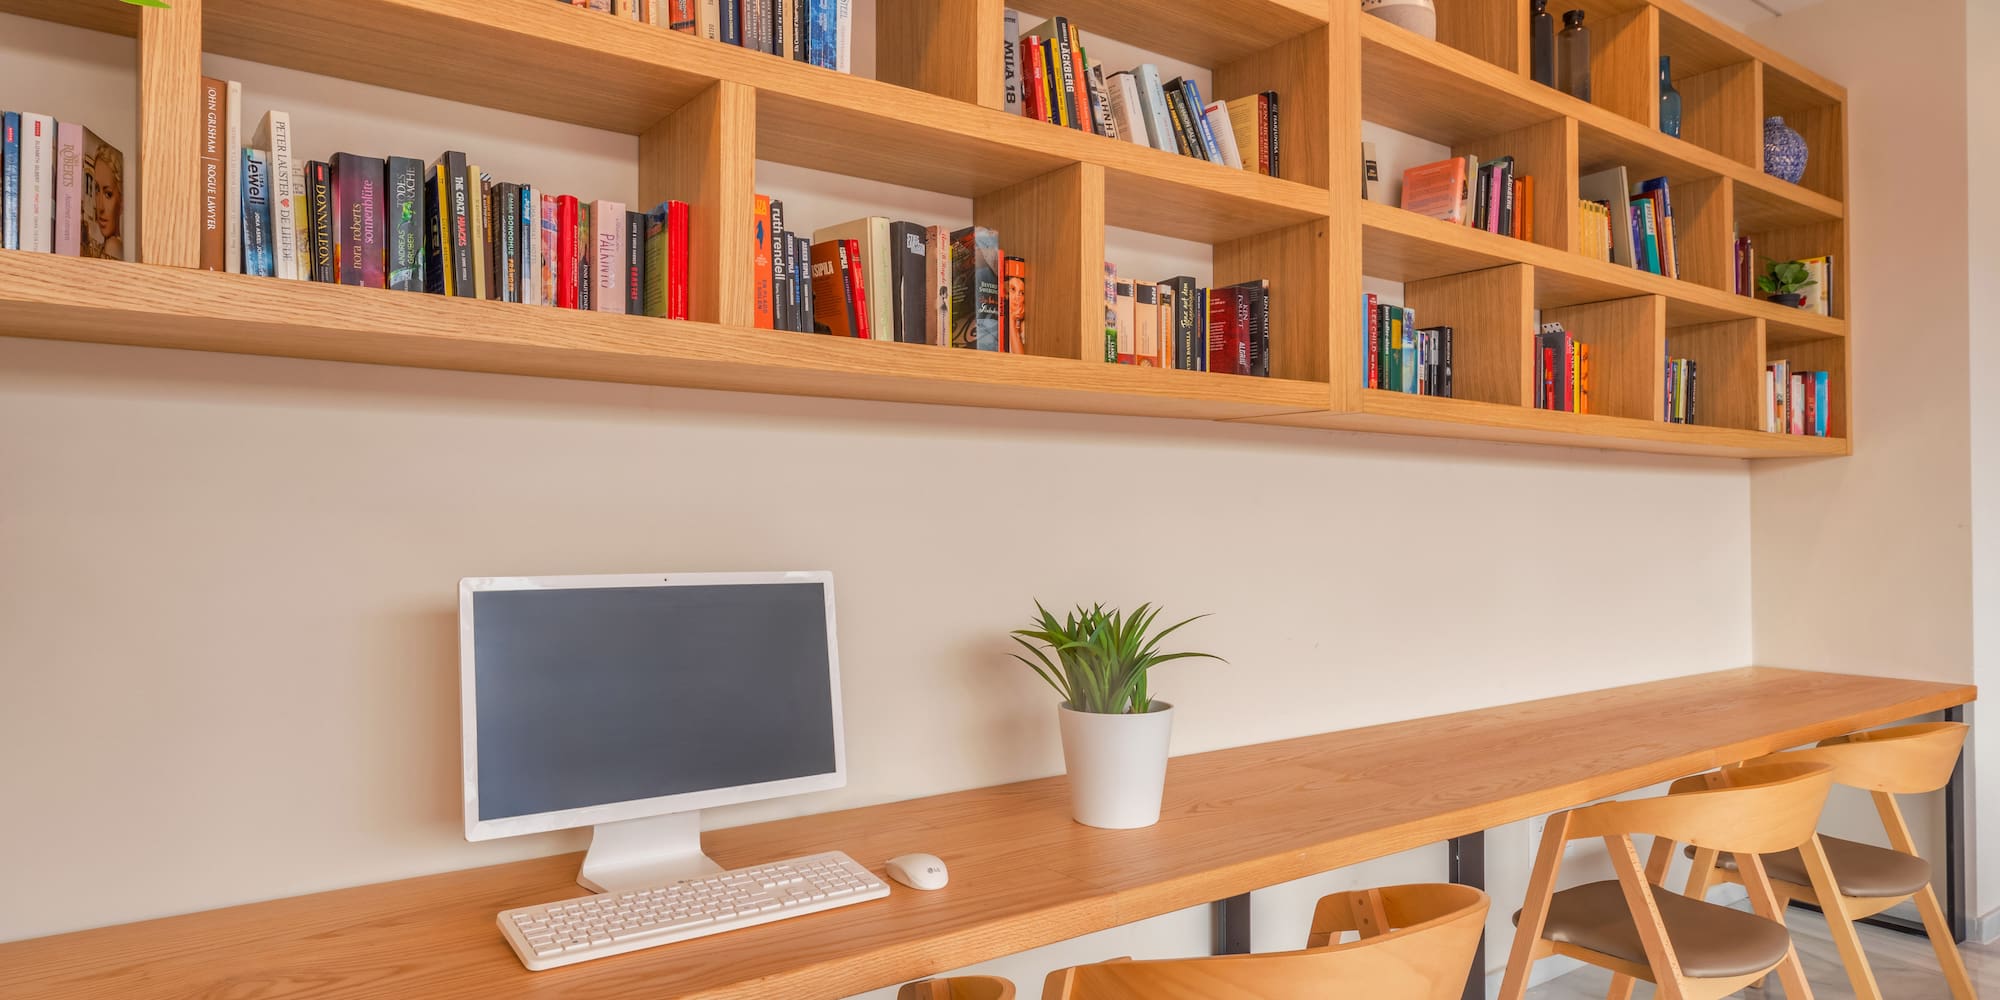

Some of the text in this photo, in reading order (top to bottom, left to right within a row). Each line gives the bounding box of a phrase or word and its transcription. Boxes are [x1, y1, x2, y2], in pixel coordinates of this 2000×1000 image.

[1003, 40, 1016, 104] MILA 18
[1060, 43, 1075, 93] LÄCKBERG
[206, 86, 217, 154] JOHN GRISHAM
[59, 143, 77, 189] ROBERTS
[246, 154, 266, 206] Jewell
[454, 176, 465, 191] THE
[206, 163, 217, 231] ROGUE LAWYER
[275, 120, 294, 263] PETER LAUSTER DE LIEFDE
[360, 179, 374, 245] sonnenblüte
[455, 191, 467, 217] CRAZY
[507, 192, 515, 214] EMMA
[315, 183, 330, 266] DONNA LEON
[350, 203, 362, 270] nora roberts
[507, 214, 516, 257] DONOGHUE
[772, 207, 784, 234] ruth
[397, 229, 406, 267] ANDREAS
[405, 232, 415, 265] GRUBER
[773, 236, 786, 281] rendell
[1237, 294, 1245, 329] FOLLETT
